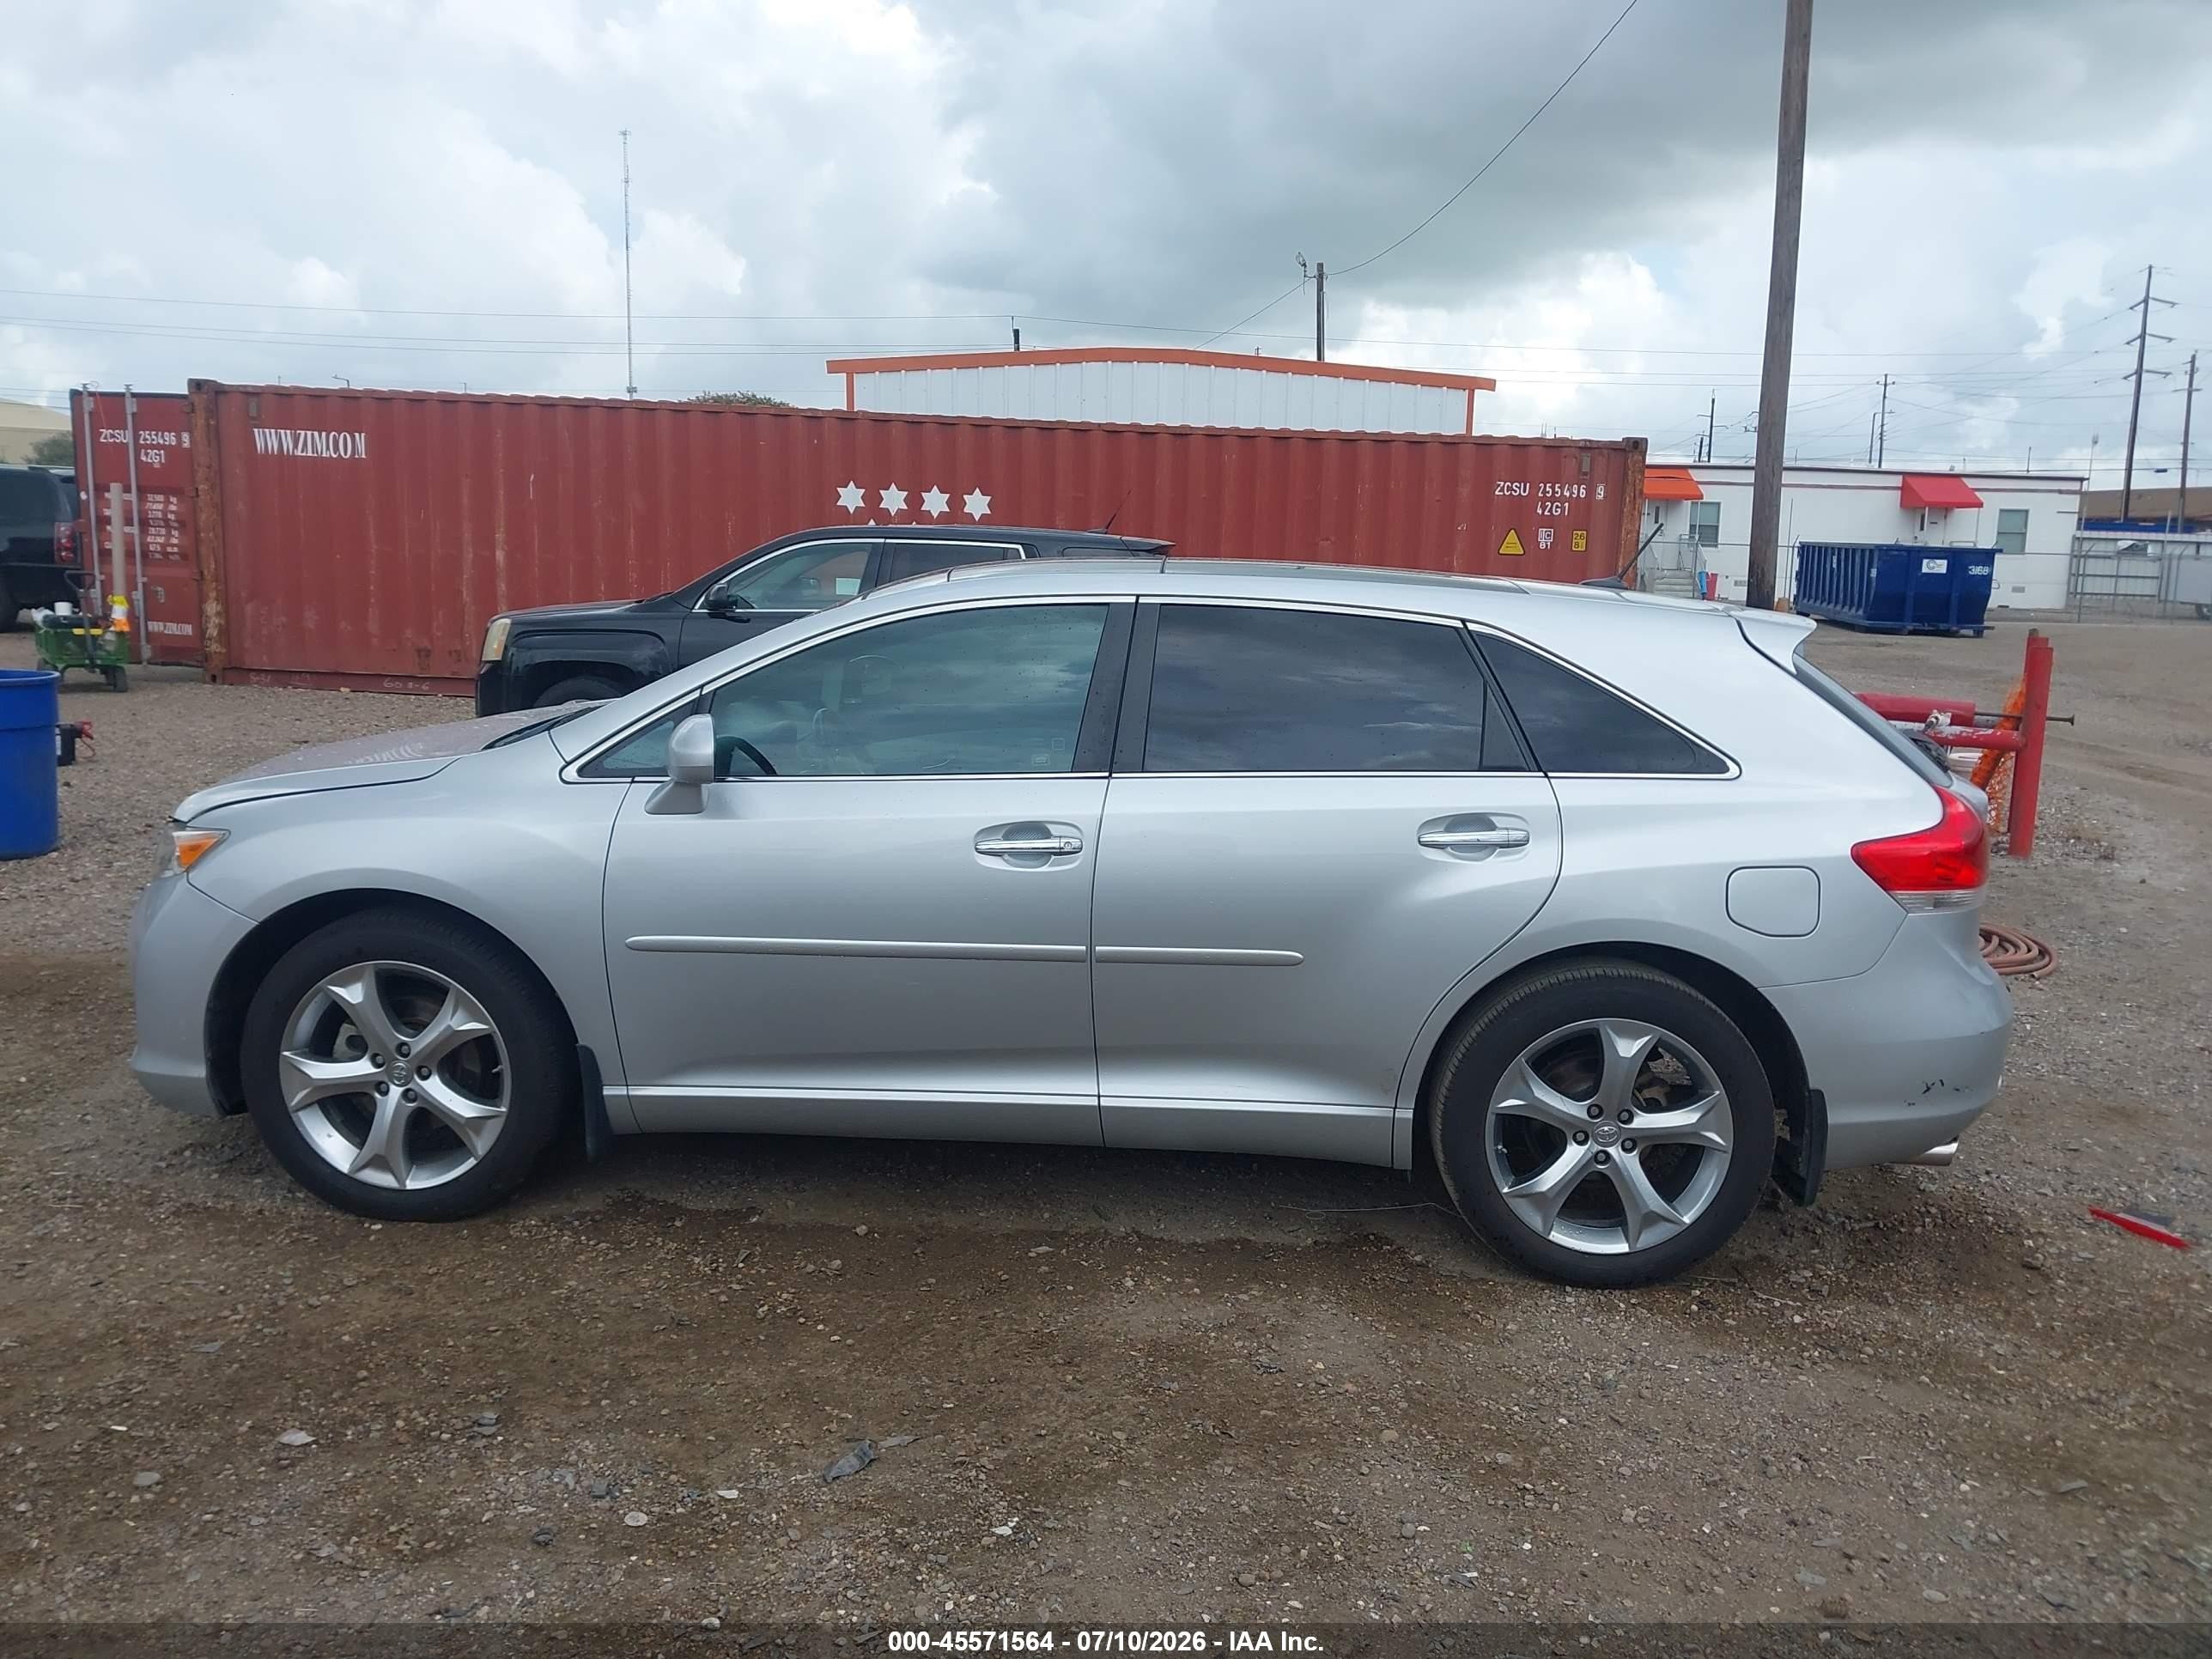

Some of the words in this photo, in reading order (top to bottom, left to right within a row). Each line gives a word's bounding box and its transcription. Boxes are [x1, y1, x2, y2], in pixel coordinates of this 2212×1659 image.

[99, 428, 129, 443] ZCSU
[138, 430, 177, 446] 255496
[140, 449, 166, 464] 42G1
[1495, 481, 1530, 496] ZCSU
[1538, 483, 1587, 498] 255496
[1596, 483, 1606, 500] 9
[1536, 501, 1570, 516] 42G1
[1967, 565, 1990, 575] 3168
